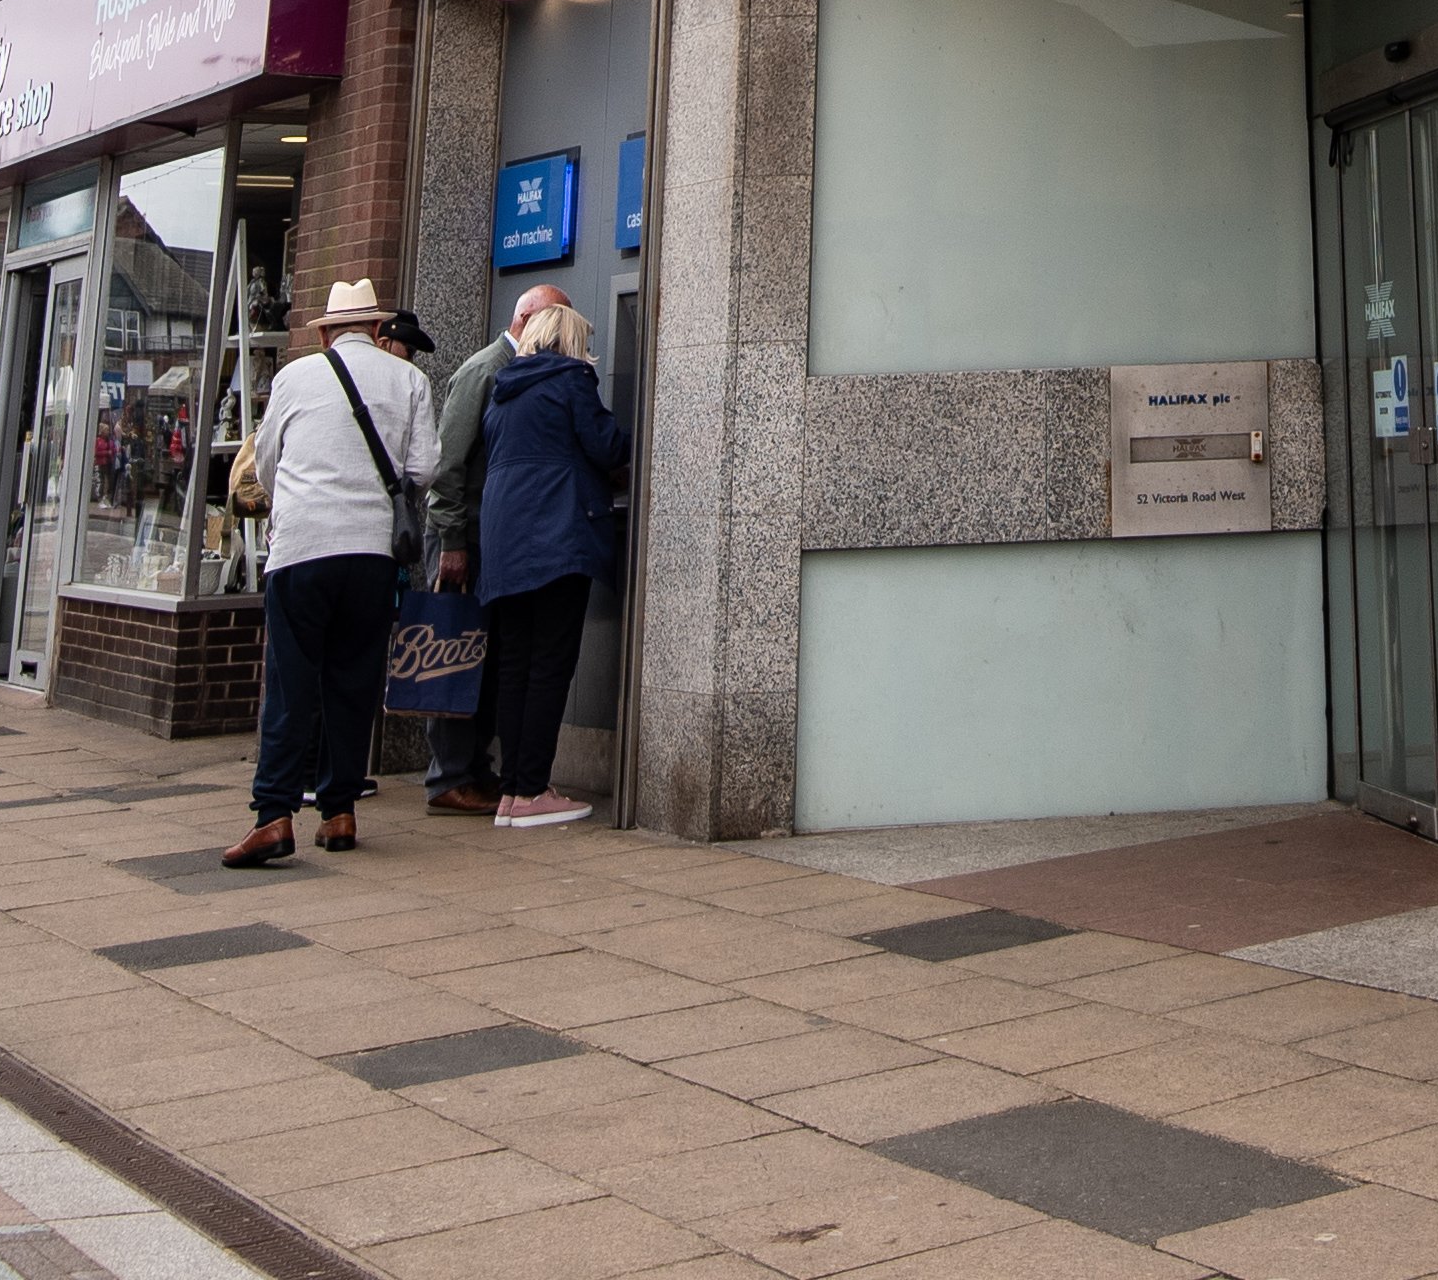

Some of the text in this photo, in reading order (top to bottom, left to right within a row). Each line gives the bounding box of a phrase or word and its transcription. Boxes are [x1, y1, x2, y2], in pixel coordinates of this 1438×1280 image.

[89, 19, 144, 81] Blackpool
[16, 79, 54, 136] shop
[517, 188, 543, 205] HALIFAX
[503, 224, 553, 249] cash machine
[1365, 299, 1395, 321] HALIFAX
[1148, 393, 1231, 406] HALIFAX plc
[1172, 443, 1207, 454] HALIFAX
[1137, 491, 1245, 504] 52 Victoria Road West
[390, 624, 489, 683] Boots
